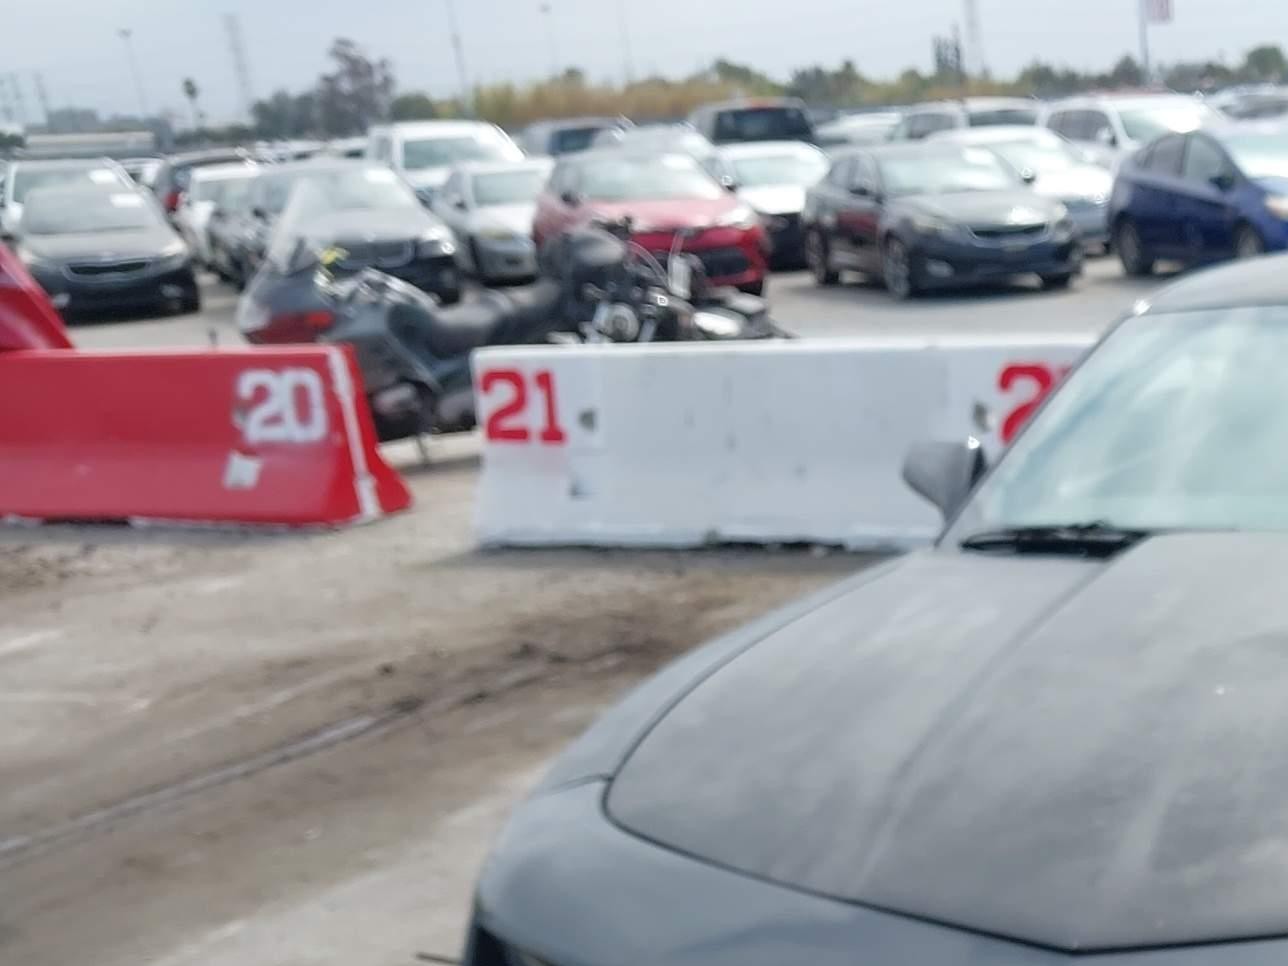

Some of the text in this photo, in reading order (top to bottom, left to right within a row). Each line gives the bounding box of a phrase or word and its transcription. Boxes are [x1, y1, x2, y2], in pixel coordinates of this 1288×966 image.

[236, 366, 330, 444] 20
[479, 368, 567, 444] 21
[999, 363, 1072, 443] 2
